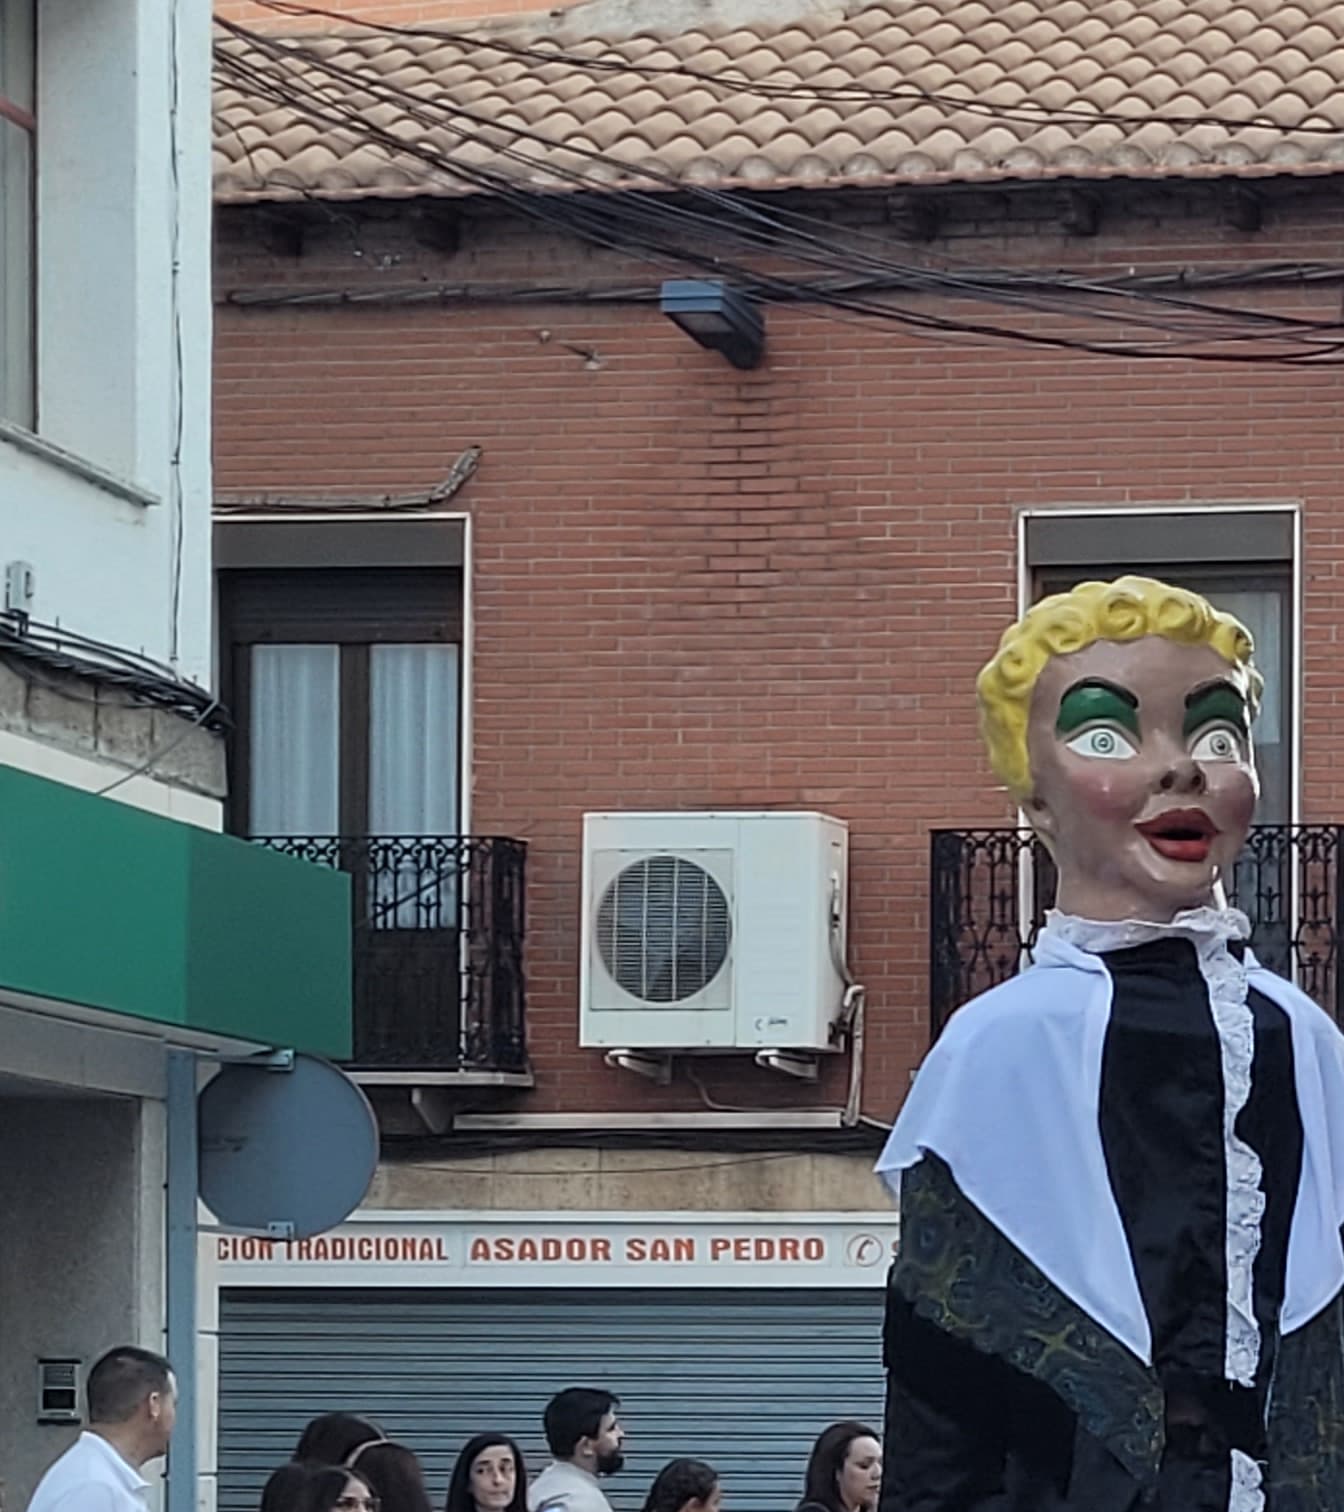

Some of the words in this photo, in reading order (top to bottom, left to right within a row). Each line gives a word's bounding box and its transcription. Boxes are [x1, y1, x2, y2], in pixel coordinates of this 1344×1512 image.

[470, 1237, 612, 1261] ASADOR
[625, 1237, 695, 1261] SAN
[710, 1237, 825, 1261] PEDRO
